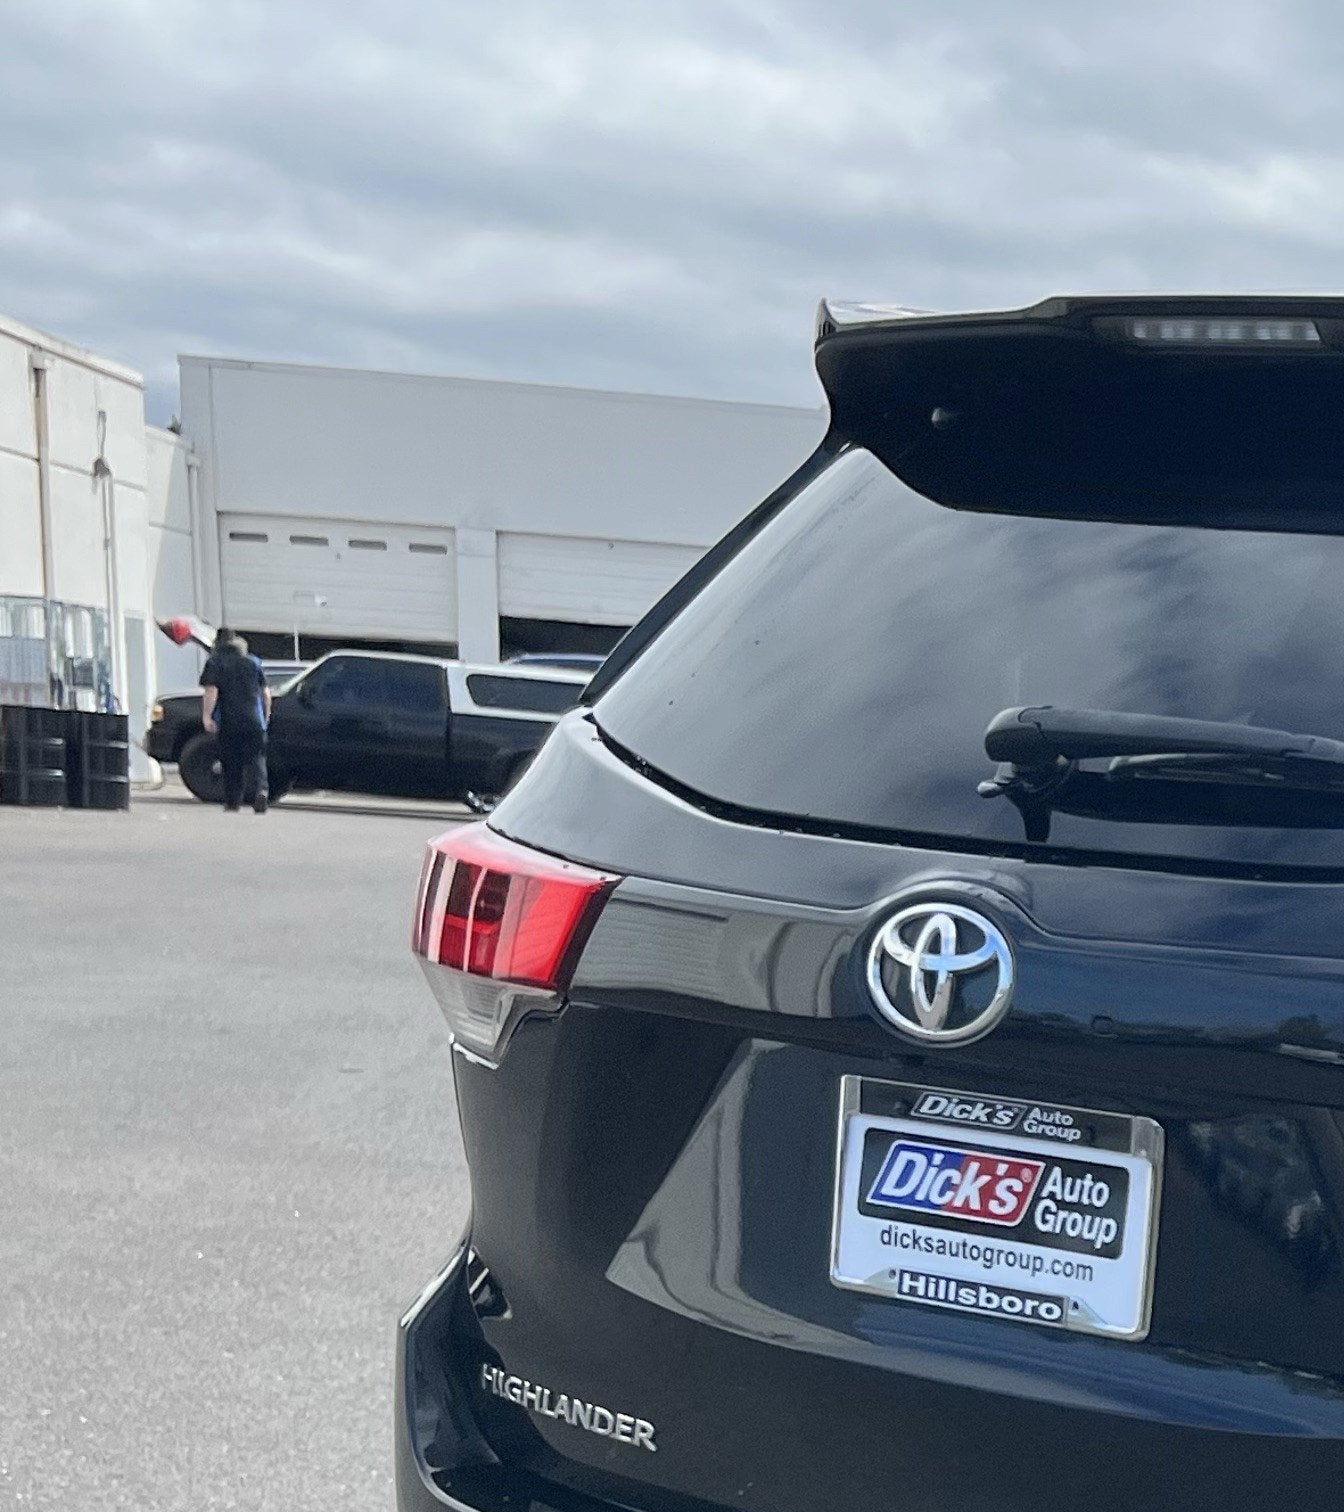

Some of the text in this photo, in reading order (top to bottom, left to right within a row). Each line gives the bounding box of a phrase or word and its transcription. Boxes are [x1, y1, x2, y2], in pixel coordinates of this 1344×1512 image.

[919, 1096, 1014, 1126] Dick's
[1023, 1120, 1082, 1142] Group
[1028, 1107, 1074, 1126] Auto
[880, 1150, 1024, 1216] Dick's
[1042, 1165, 1111, 1208] Auto
[1034, 1199, 1118, 1250] Group
[880, 1225, 1094, 1282] dicksautogroup.com
[902, 1272, 1063, 1322] Hillsboro
[481, 1363, 658, 1452] HIGHLANDER
